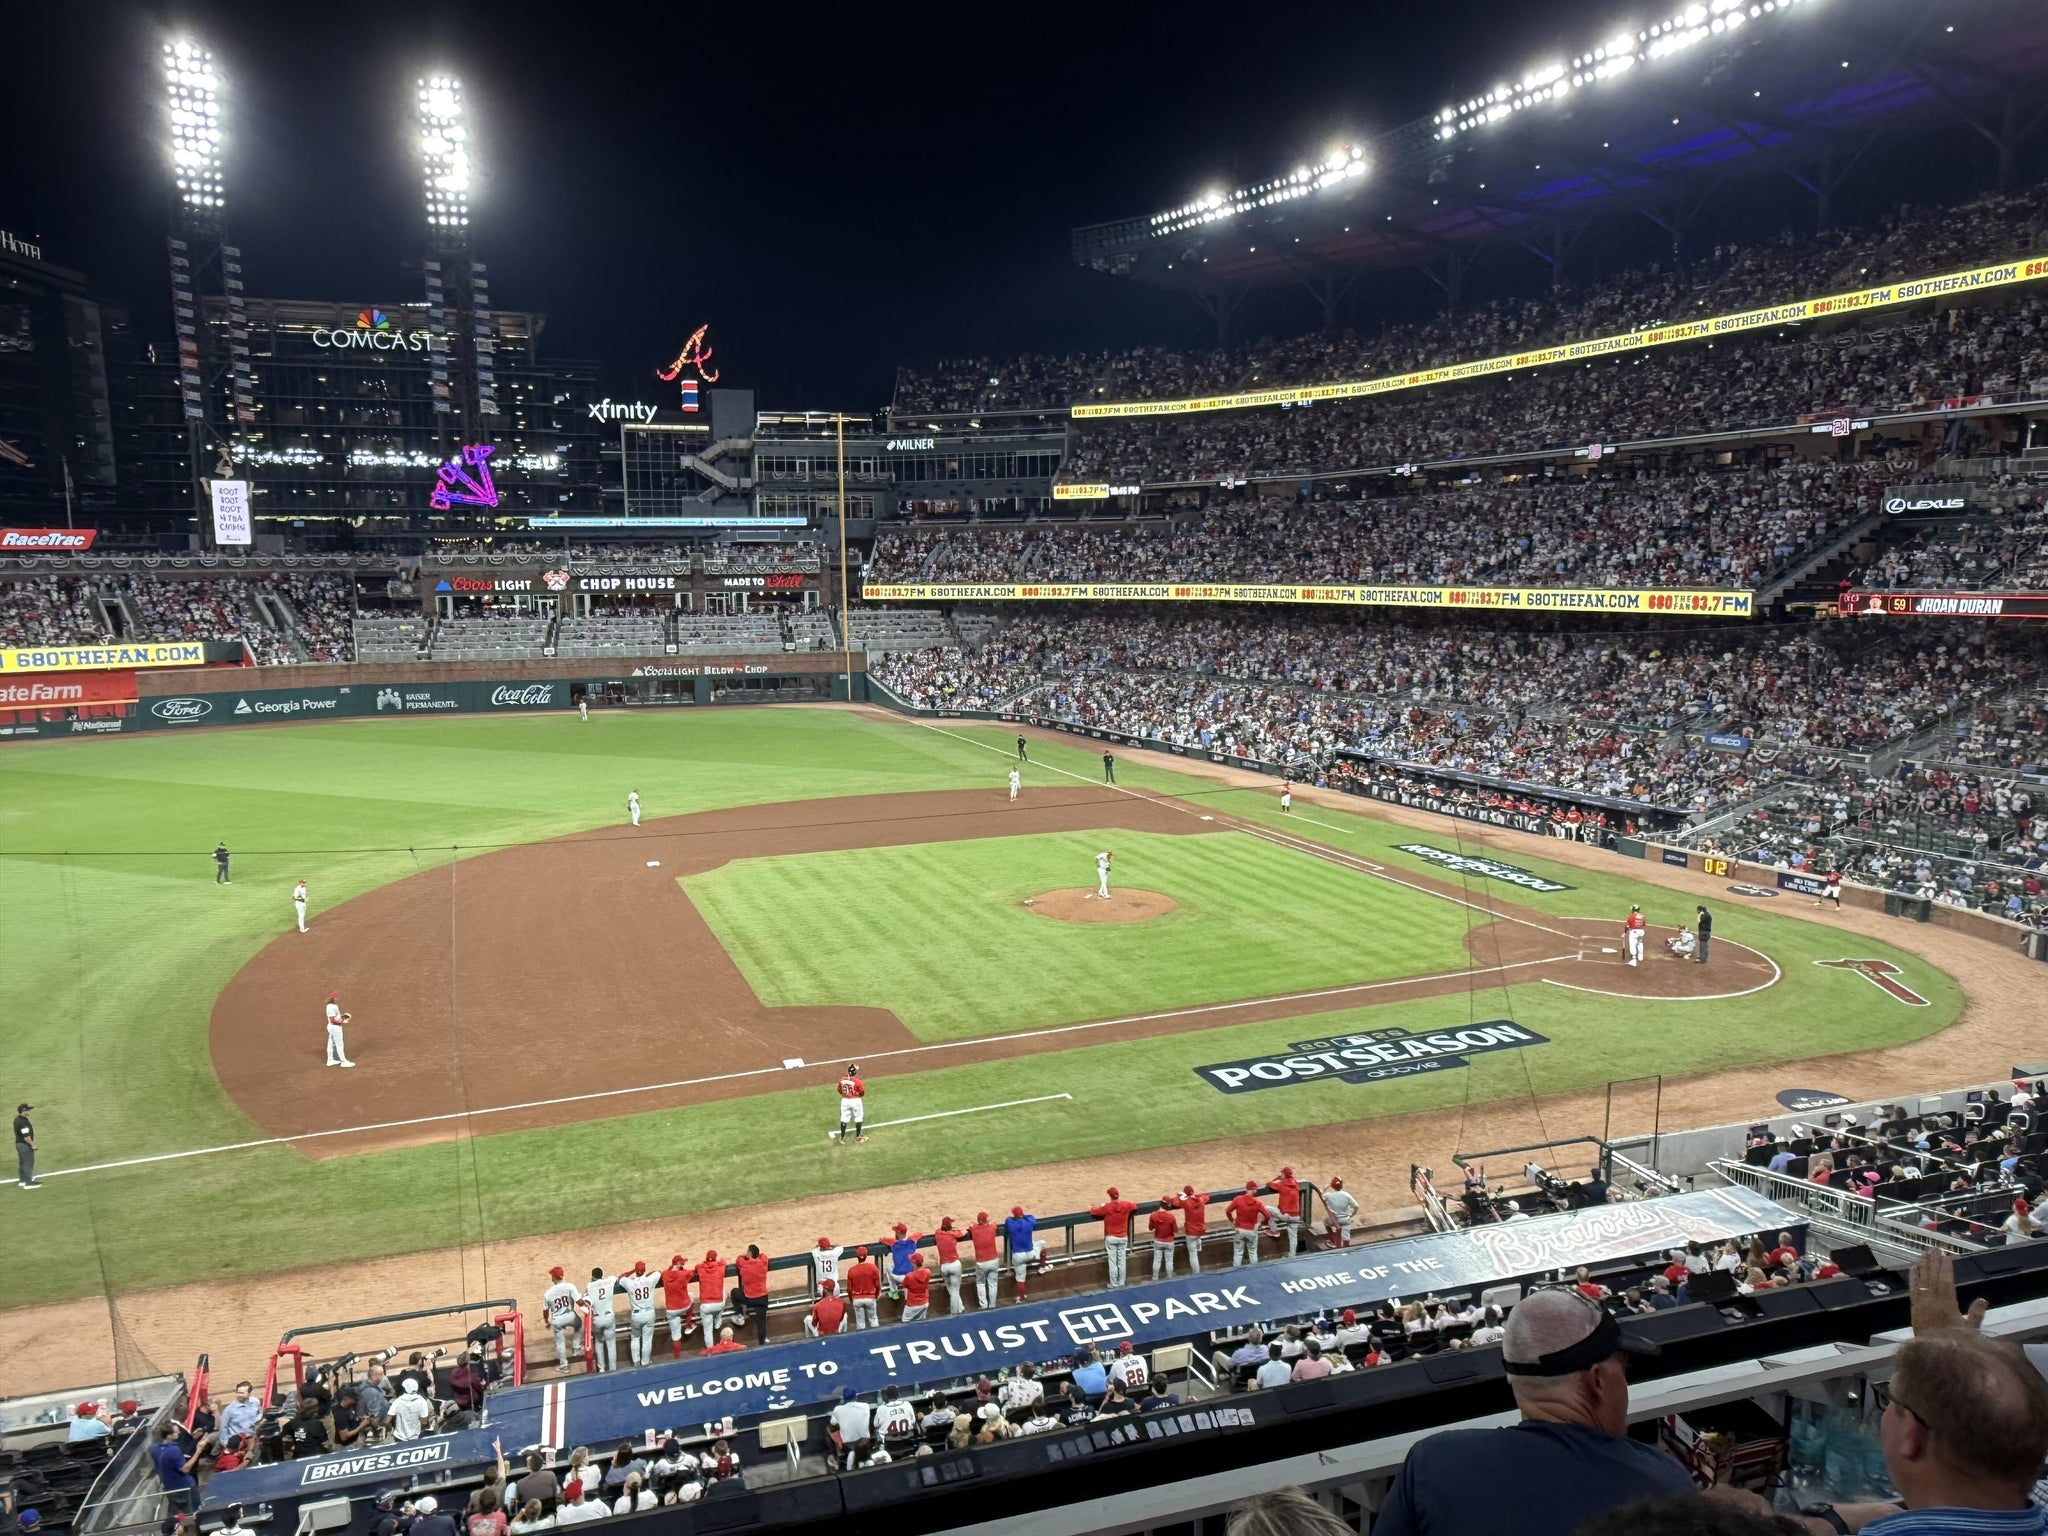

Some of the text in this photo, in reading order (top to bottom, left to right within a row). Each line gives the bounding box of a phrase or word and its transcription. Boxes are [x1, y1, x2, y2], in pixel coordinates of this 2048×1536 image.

[1714, 304, 1807, 331] 680THEFAN.COM
[1813, 300, 1832, 314] 680
[1898, 266, 2018, 299] 680THEFAN.COM
[313, 329, 434, 352] COMCAST
[588, 398, 658, 424] xfinity
[896, 438, 934, 450] MILNER
[219, 488, 239, 496] ROOT
[220, 496, 239, 505] ROOT
[1907, 499, 1964, 510] LEXUS
[220, 506, 242, 514] ROOT
[2, 532, 86, 546] RaceTrac
[452, 576, 532, 591] Coors LIGHT
[580, 577, 675, 590] CHOP HOUSE
[724, 577, 751, 587] MADE
[752, 577, 765, 586] TO
[931, 587, 1016, 597] 680THEFAN.COM
[1022, 587, 1039, 597] 680
[1092, 587, 1169, 597] 680THEFAN.COM
[1175, 587, 1191, 597] 680
[1234, 588, 1297, 599] 680THEFAN.COM
[1360, 590, 1442, 604] 680THEFAN.COM
[1449, 591, 1466, 604] 680
[1527, 592, 1640, 608] 680THEFAN.COM
[1648, 594, 1673, 610] 680
[1893, 598, 2003, 614] 59 JHOAN DURAN
[16, 646, 201, 668] 680THEFAN.COM
[644, 665, 672, 677] Coors
[673, 667, 700, 676] LIGHT
[745, 665, 768, 674] CHOP
[32, 683, 82, 701] Farm
[406, 693, 431, 701] KAISER
[491, 684, 554, 706] Coca-Cola
[163, 701, 201, 716] Ford
[255, 698, 337, 714] Georgia Power
[406, 701, 456, 709] PERMANENTE
[84, 719, 122, 730] National
[1400, 844, 1567, 891] POSTSEASON
[1209, 1025, 1533, 1088] POSTSEASON
[1367, 1061, 1441, 1078] abbvie
[821, 1260, 832, 1273] 13
[598, 1288, 606, 1300] 2
[634, 1286, 650, 1301] 88
[637, 1257, 1444, 1408] WELCOME TO TRUIST PARK HOME OF THE
[1125, 1368, 1145, 1387] 28
[887, 1418, 909, 1435] 40
[310, 1445, 441, 1481] BRAVES.COM
